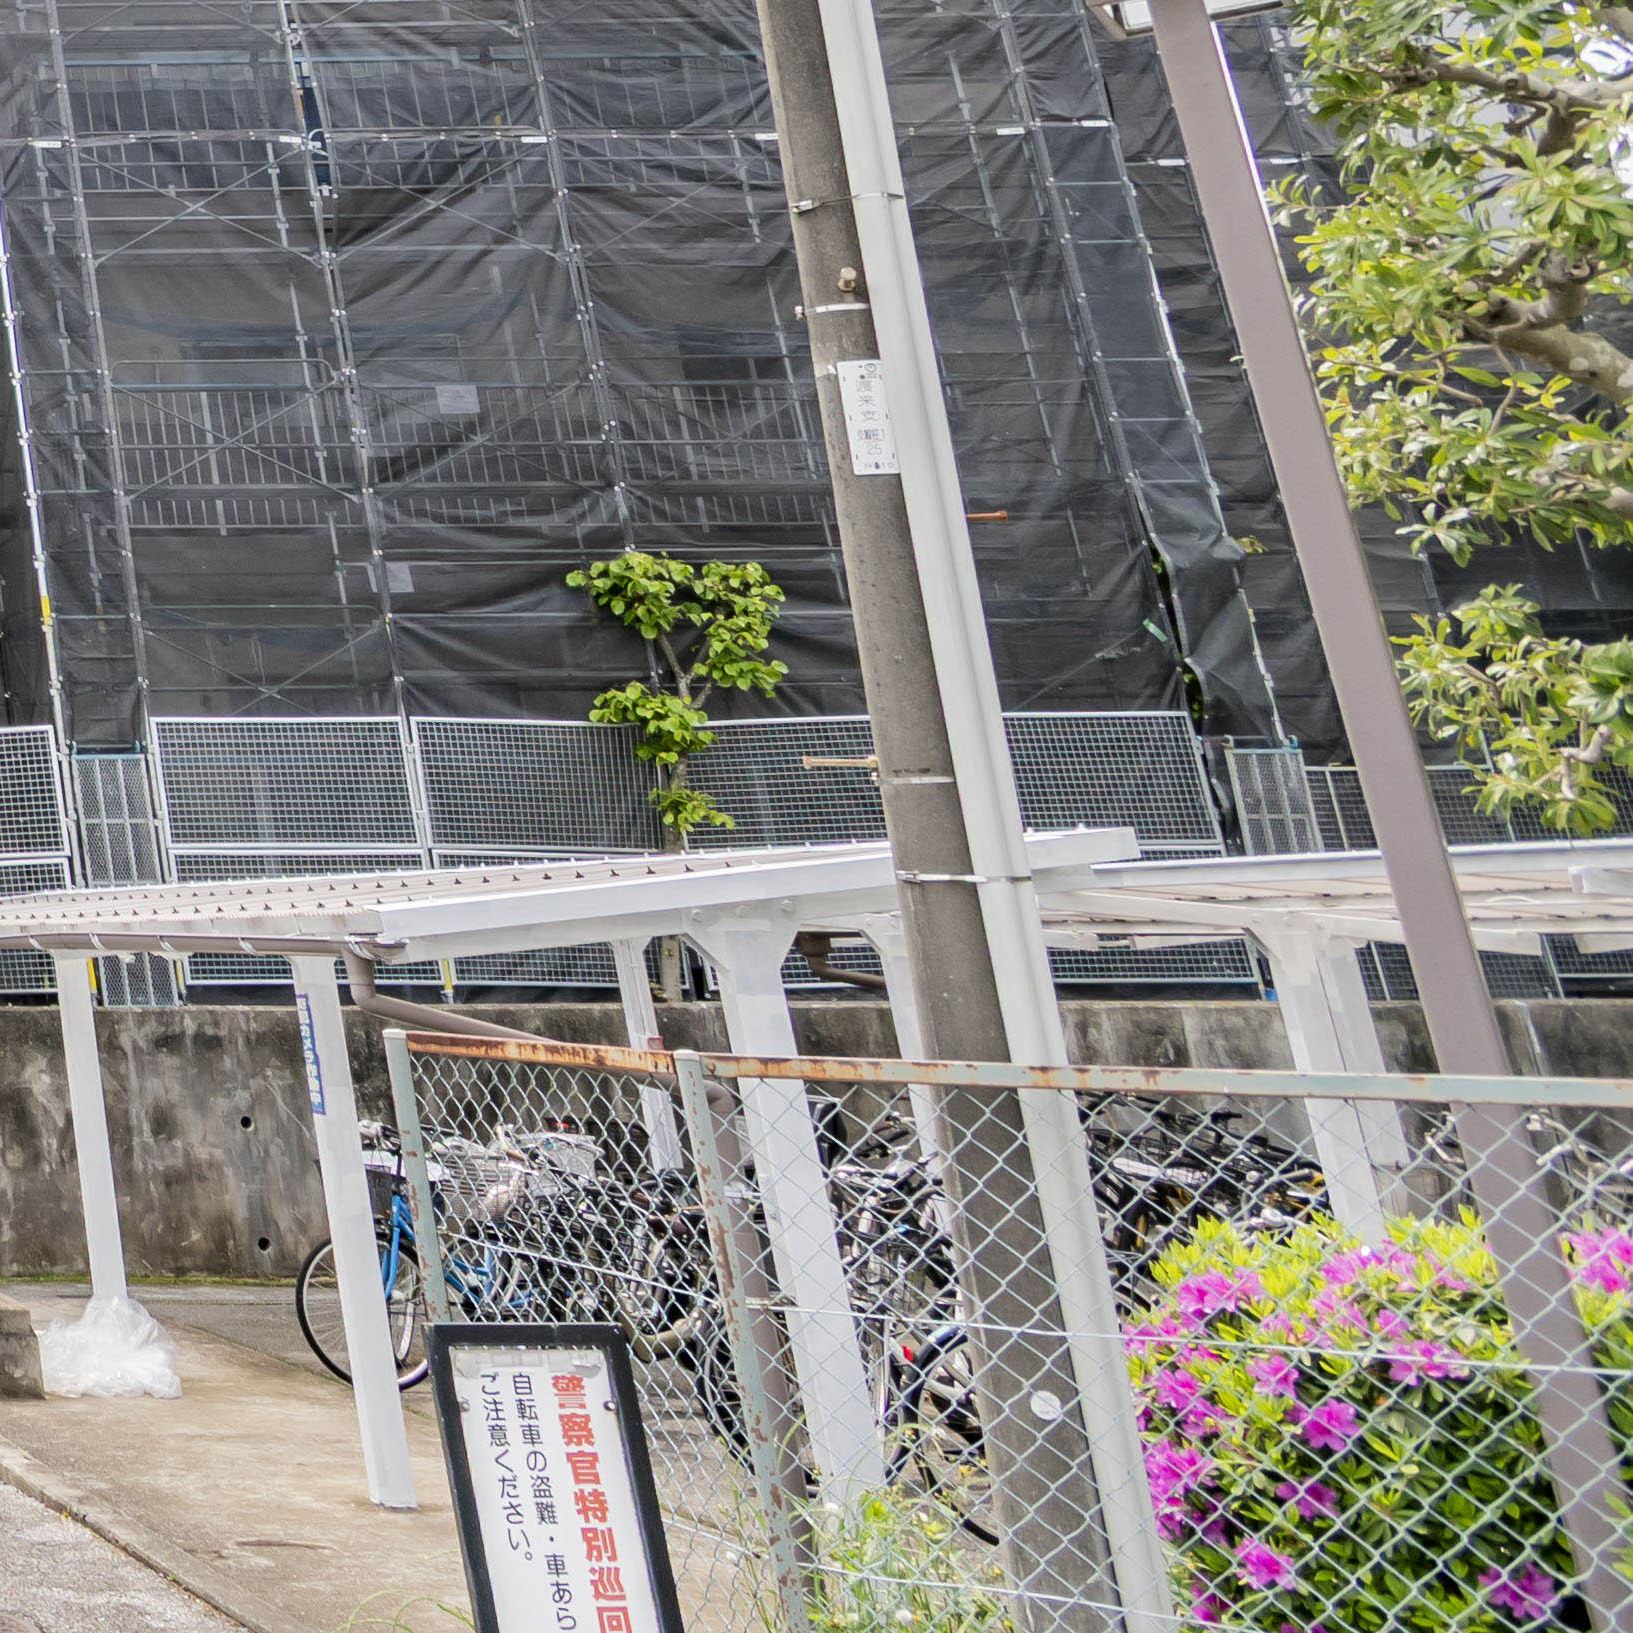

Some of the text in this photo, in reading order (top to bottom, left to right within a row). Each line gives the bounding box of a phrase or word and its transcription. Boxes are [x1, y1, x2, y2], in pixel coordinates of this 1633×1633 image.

[550, 1374, 633, 1633] 警察官特別巡回
